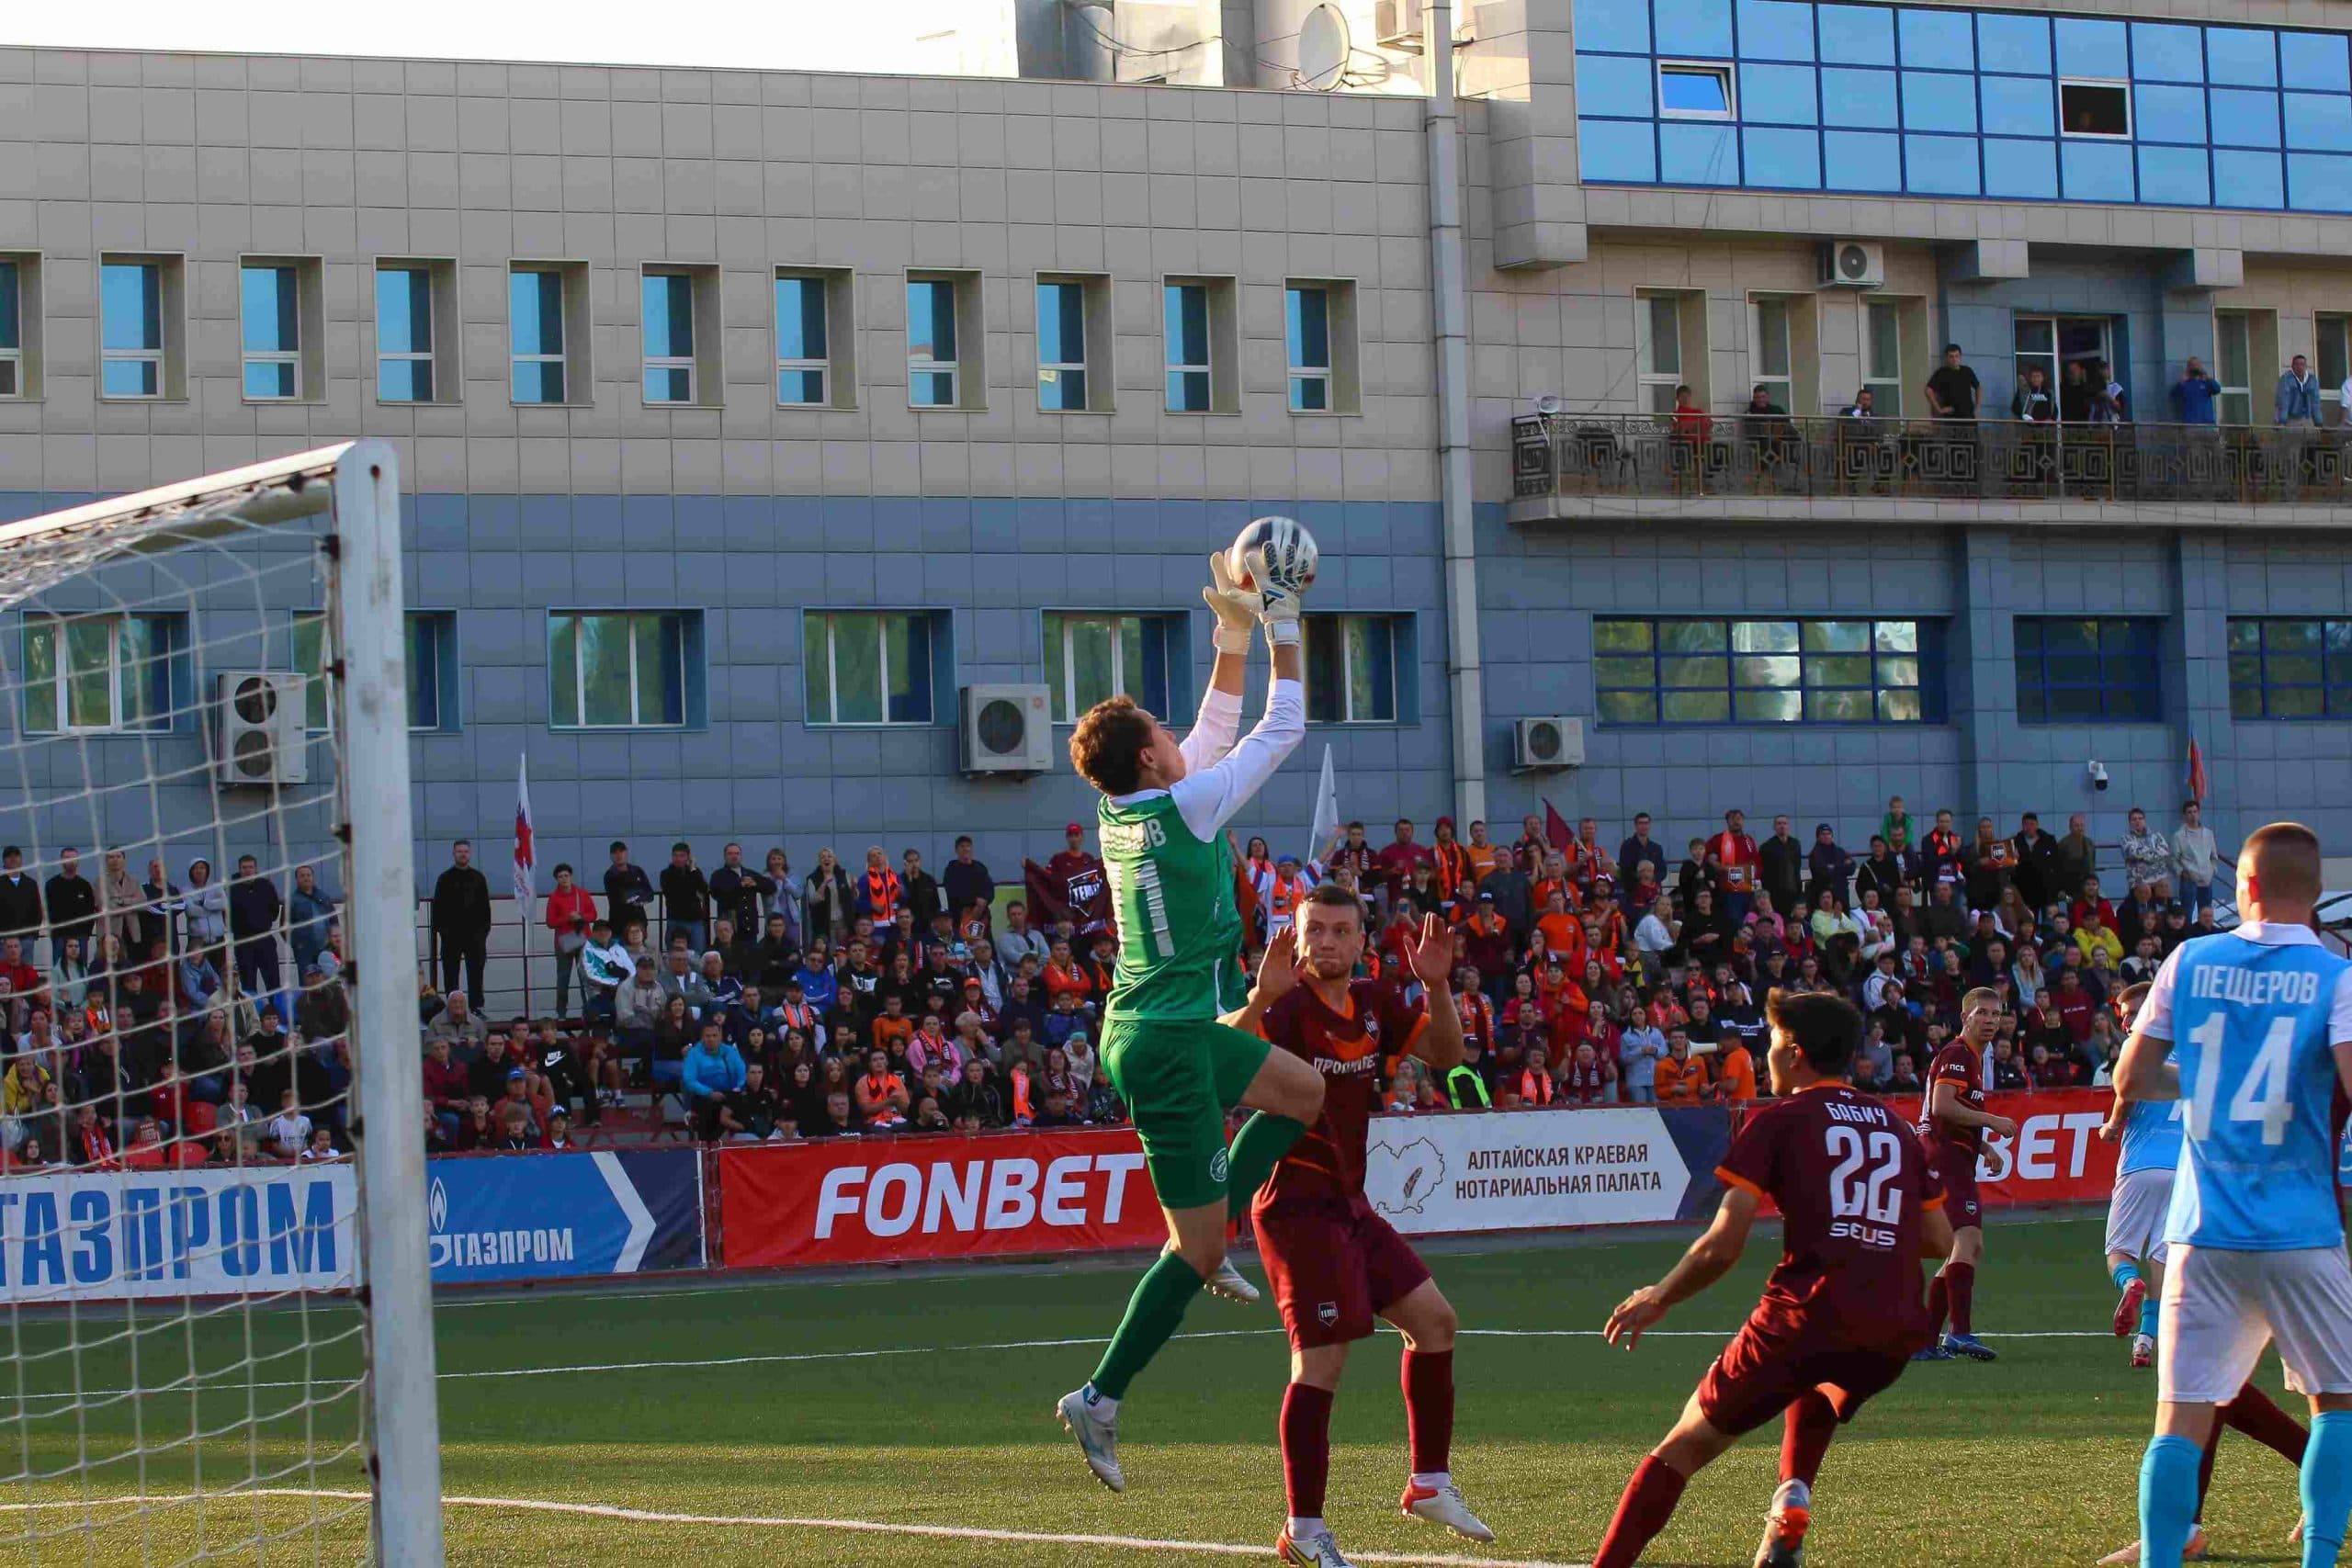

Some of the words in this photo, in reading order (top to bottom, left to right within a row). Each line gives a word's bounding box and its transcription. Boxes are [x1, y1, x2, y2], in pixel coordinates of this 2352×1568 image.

[2191, 964, 2319, 1007] ПЕЩЕРОВ
[1949, 1064, 1966, 1073] ПСБ
[2188, 1012, 2296, 1145] 14
[1825, 1101, 1888, 1127] БАБИЧ
[1467, 1145, 1569, 1170] АЛТАЙСКАЯ
[1575, 1144, 1648, 1166] КРАЕВАЯ
[1455, 1175, 1591, 1200] НОТАРИАЛЬНАЯ
[1596, 1171, 1662, 1193] ПАЛАТА
[1825, 1125, 1904, 1225] 22
[814, 1153, 1145, 1240] FONBET
[453, 1227, 574, 1267] ГАЗПРОМ
[1829, 1222, 1896, 1247] SEUS
